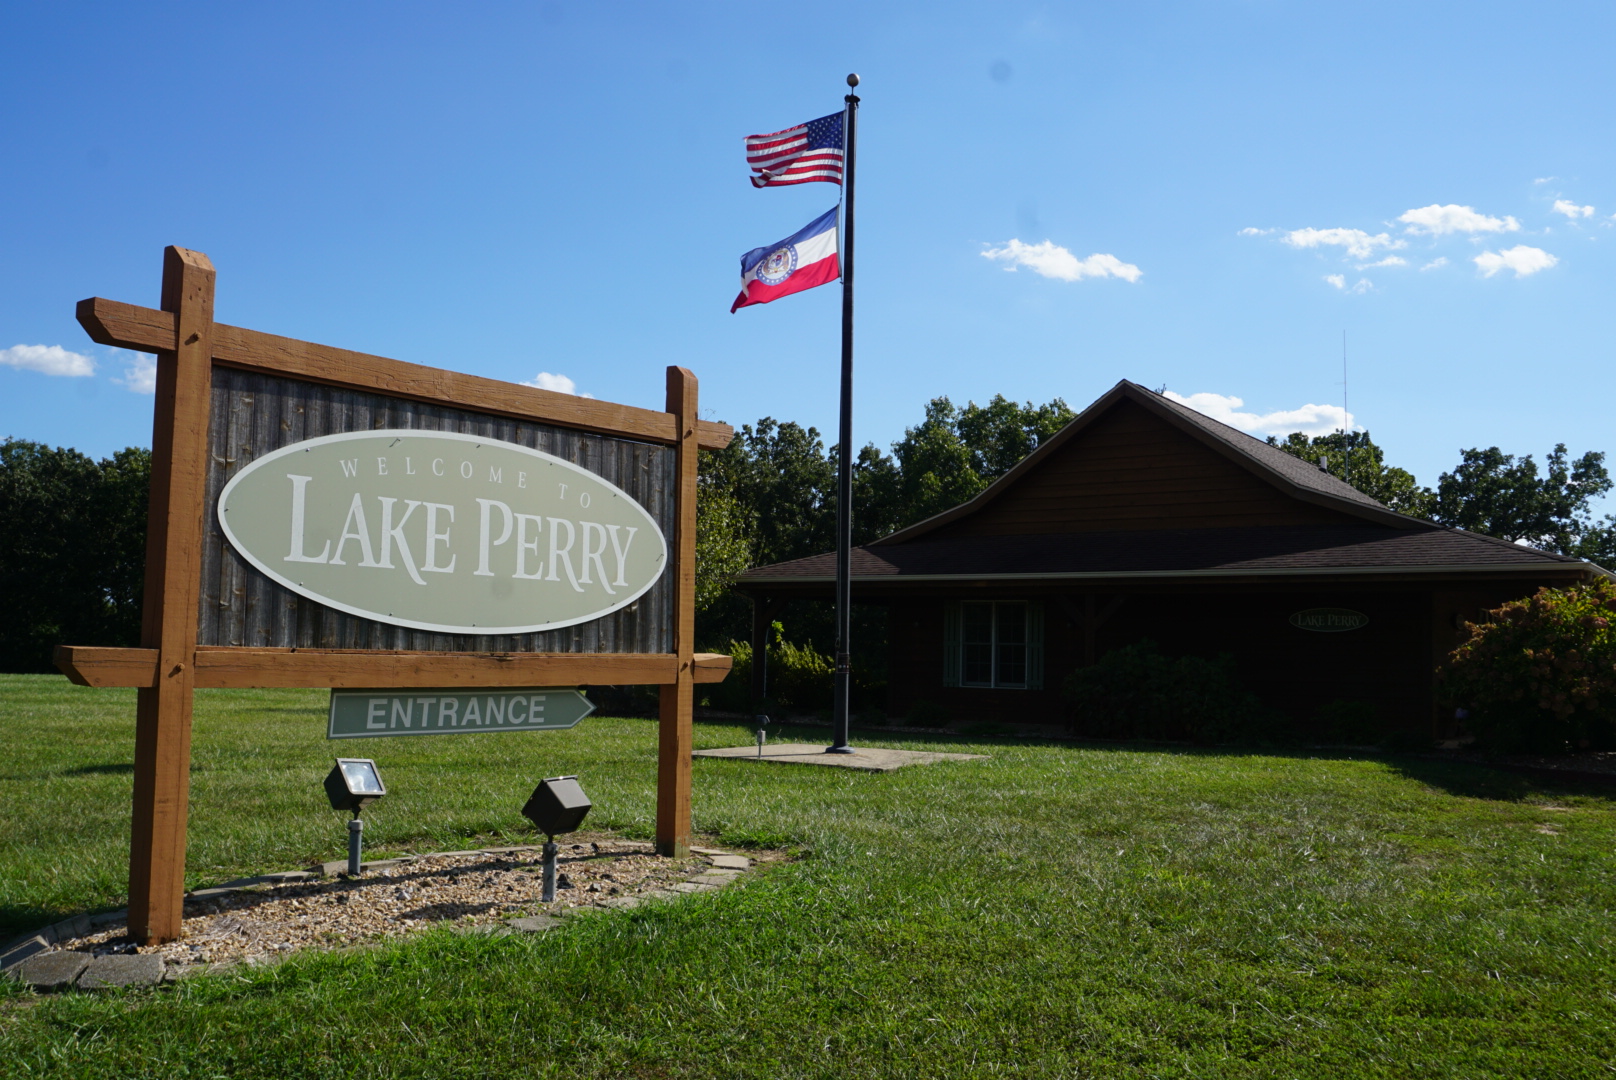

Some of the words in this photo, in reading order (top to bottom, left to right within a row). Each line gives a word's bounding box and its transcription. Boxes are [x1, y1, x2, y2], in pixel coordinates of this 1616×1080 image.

[340, 456, 527, 488] WELCOME
[558, 482, 591, 509] TO
[284, 473, 457, 586] LAKE
[473, 498, 638, 595] PERRY
[1298, 613, 1325, 628] LAKE
[1327, 613, 1362, 628] PERRY
[366, 695, 546, 730] ENTRANCE
